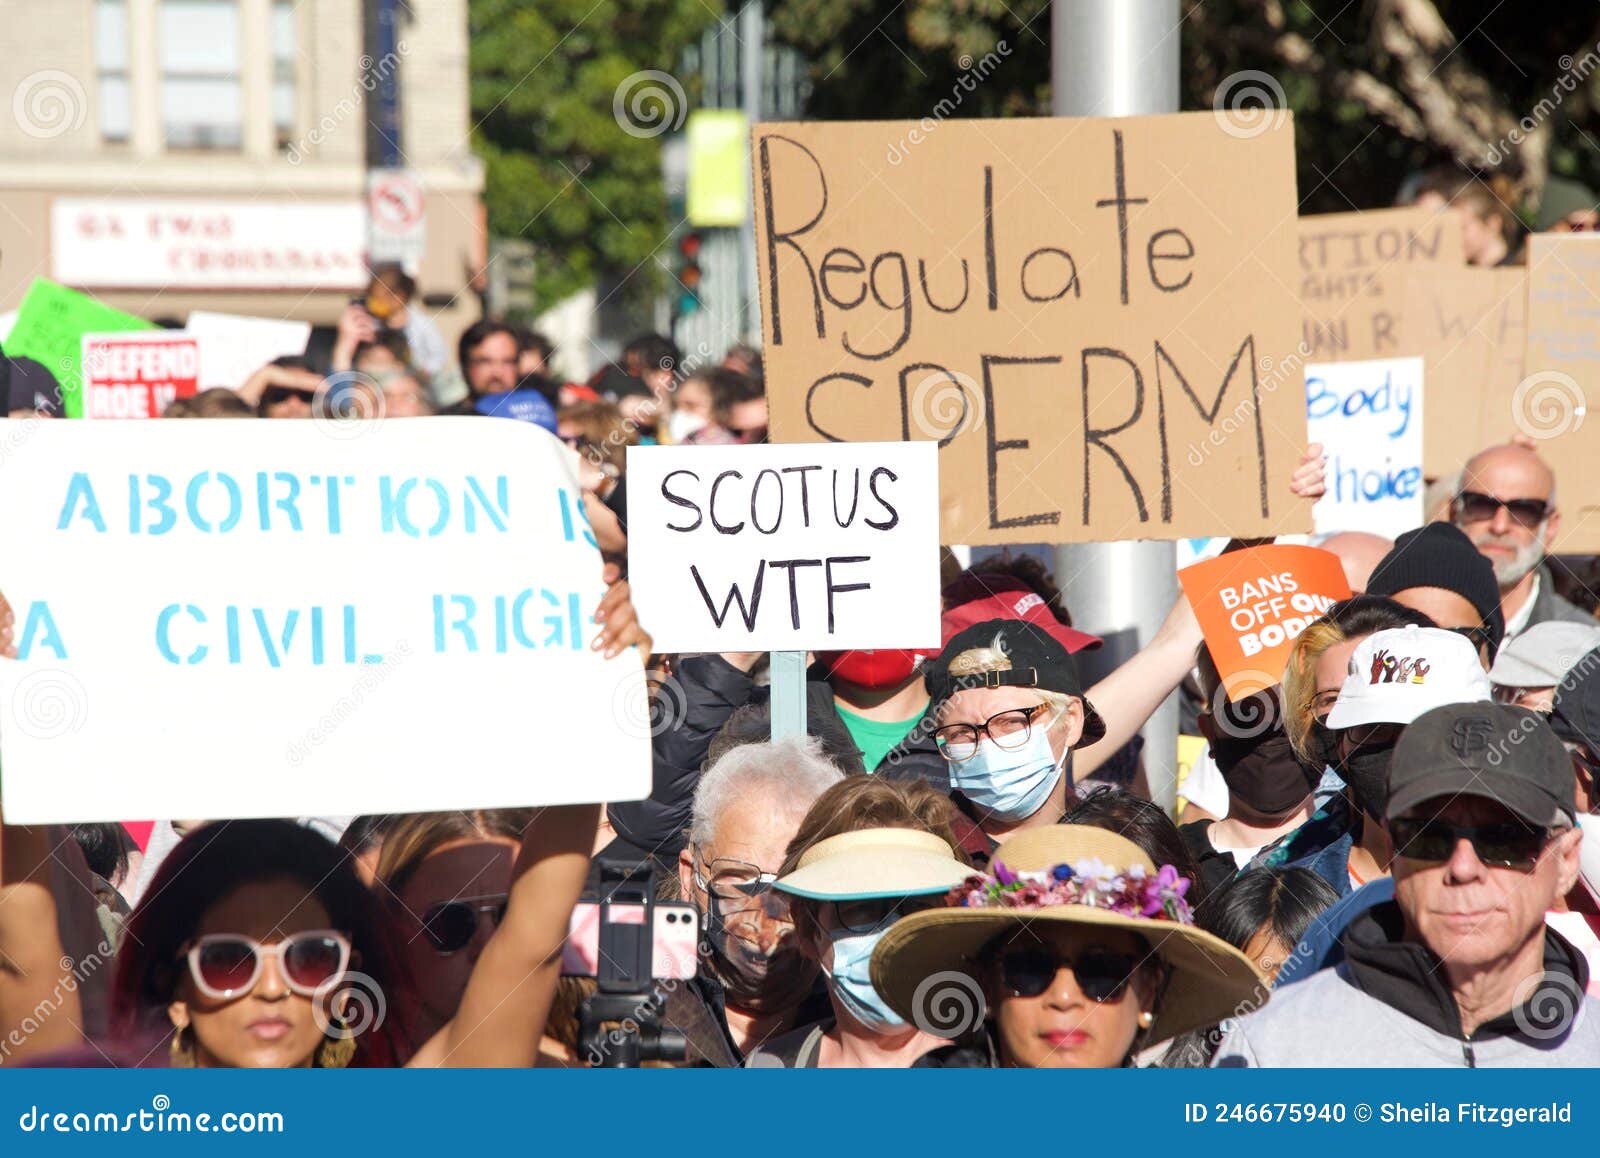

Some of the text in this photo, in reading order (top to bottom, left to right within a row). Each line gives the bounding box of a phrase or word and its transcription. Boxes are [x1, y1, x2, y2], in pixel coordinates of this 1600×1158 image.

[760, 129, 1195, 361] Regulate
[91, 346, 197, 380] DEFEND
[1305, 369, 1412, 439] Body
[56, 471, 510, 537] ABORTION
[661, 465, 899, 534] SCOTUS
[1322, 455, 1421, 503] hoice
[690, 556, 871, 634] WTF
[1219, 572, 1298, 610] BANS
[1230, 593, 1338, 631] OFF OU
[15, 601, 69, 661] A
[155, 604, 383, 668] CIVIL
